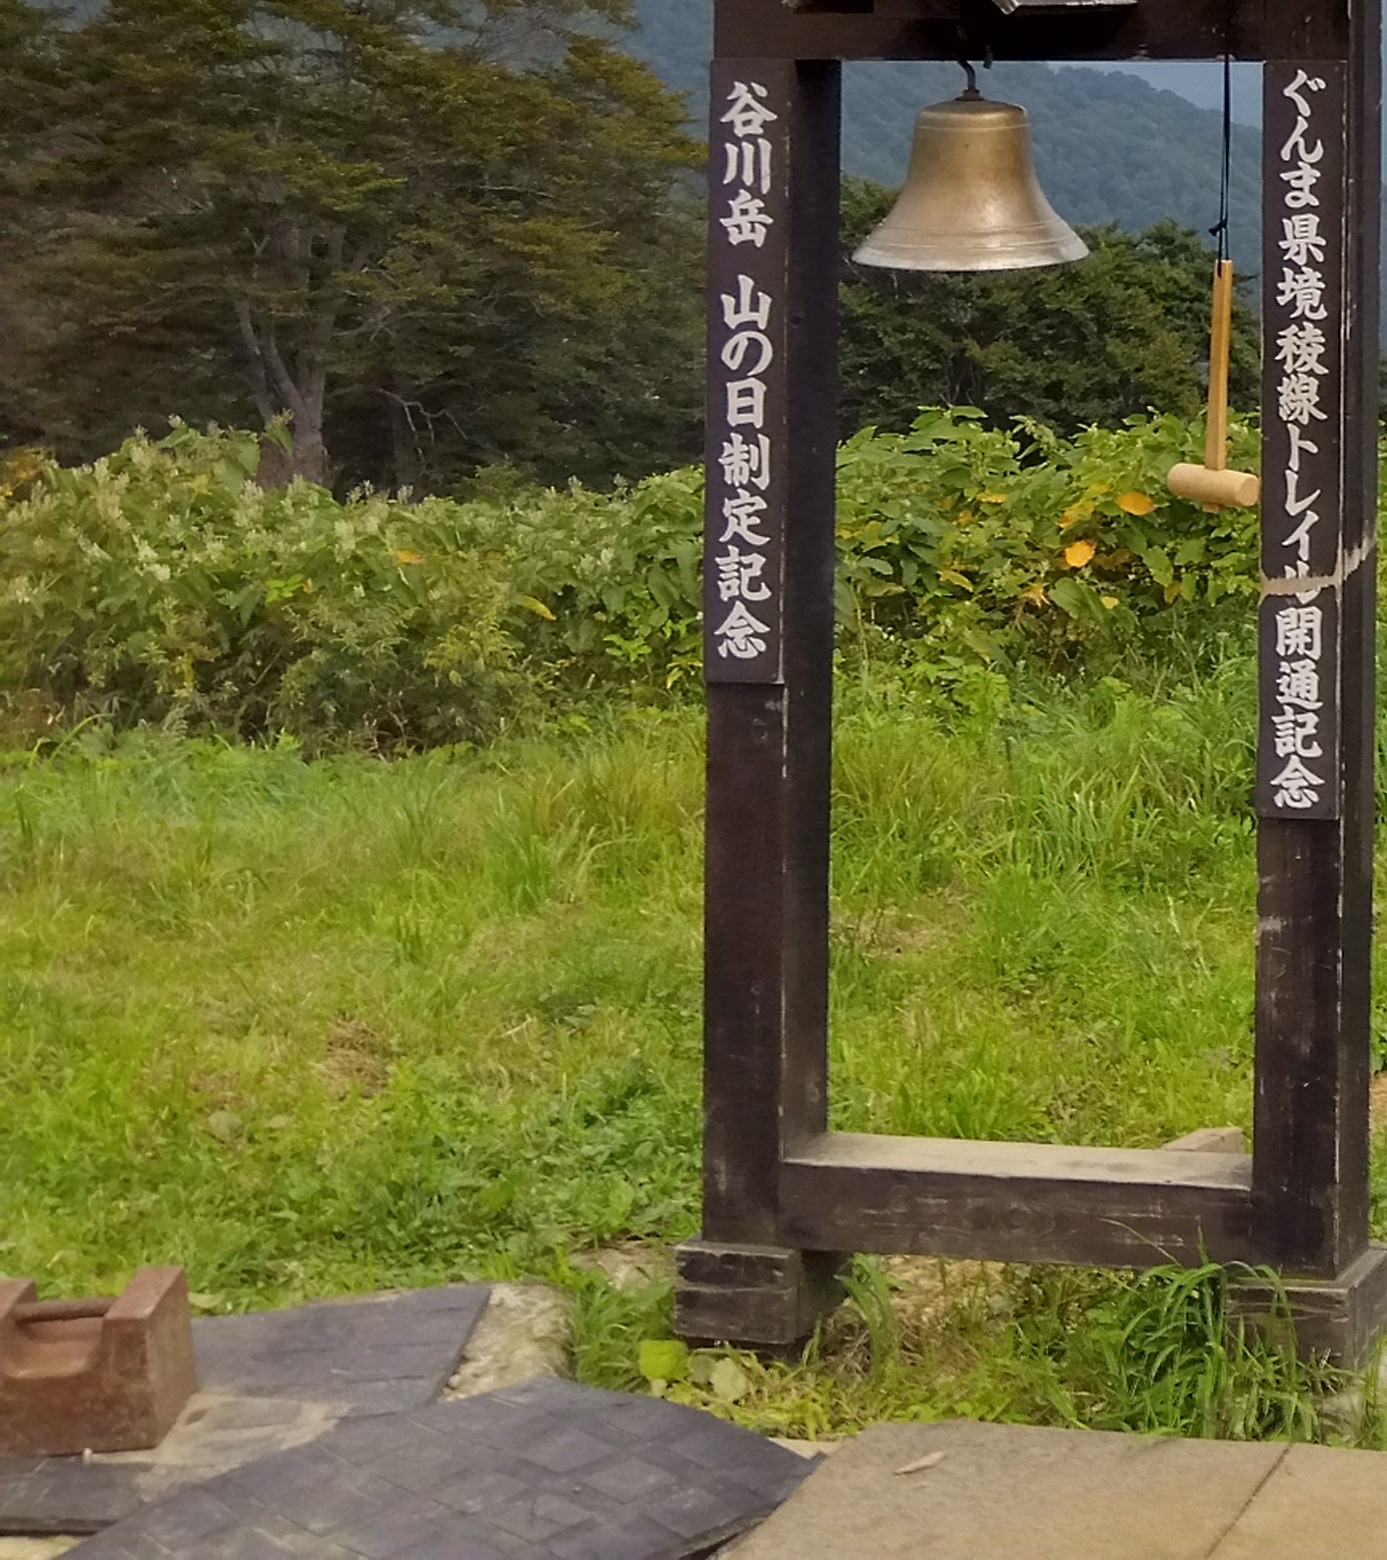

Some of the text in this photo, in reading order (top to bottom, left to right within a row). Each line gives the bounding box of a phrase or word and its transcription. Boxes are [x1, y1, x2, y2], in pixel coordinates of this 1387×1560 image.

[713, 81, 778, 659] 谷川岳 山の日制定記念
